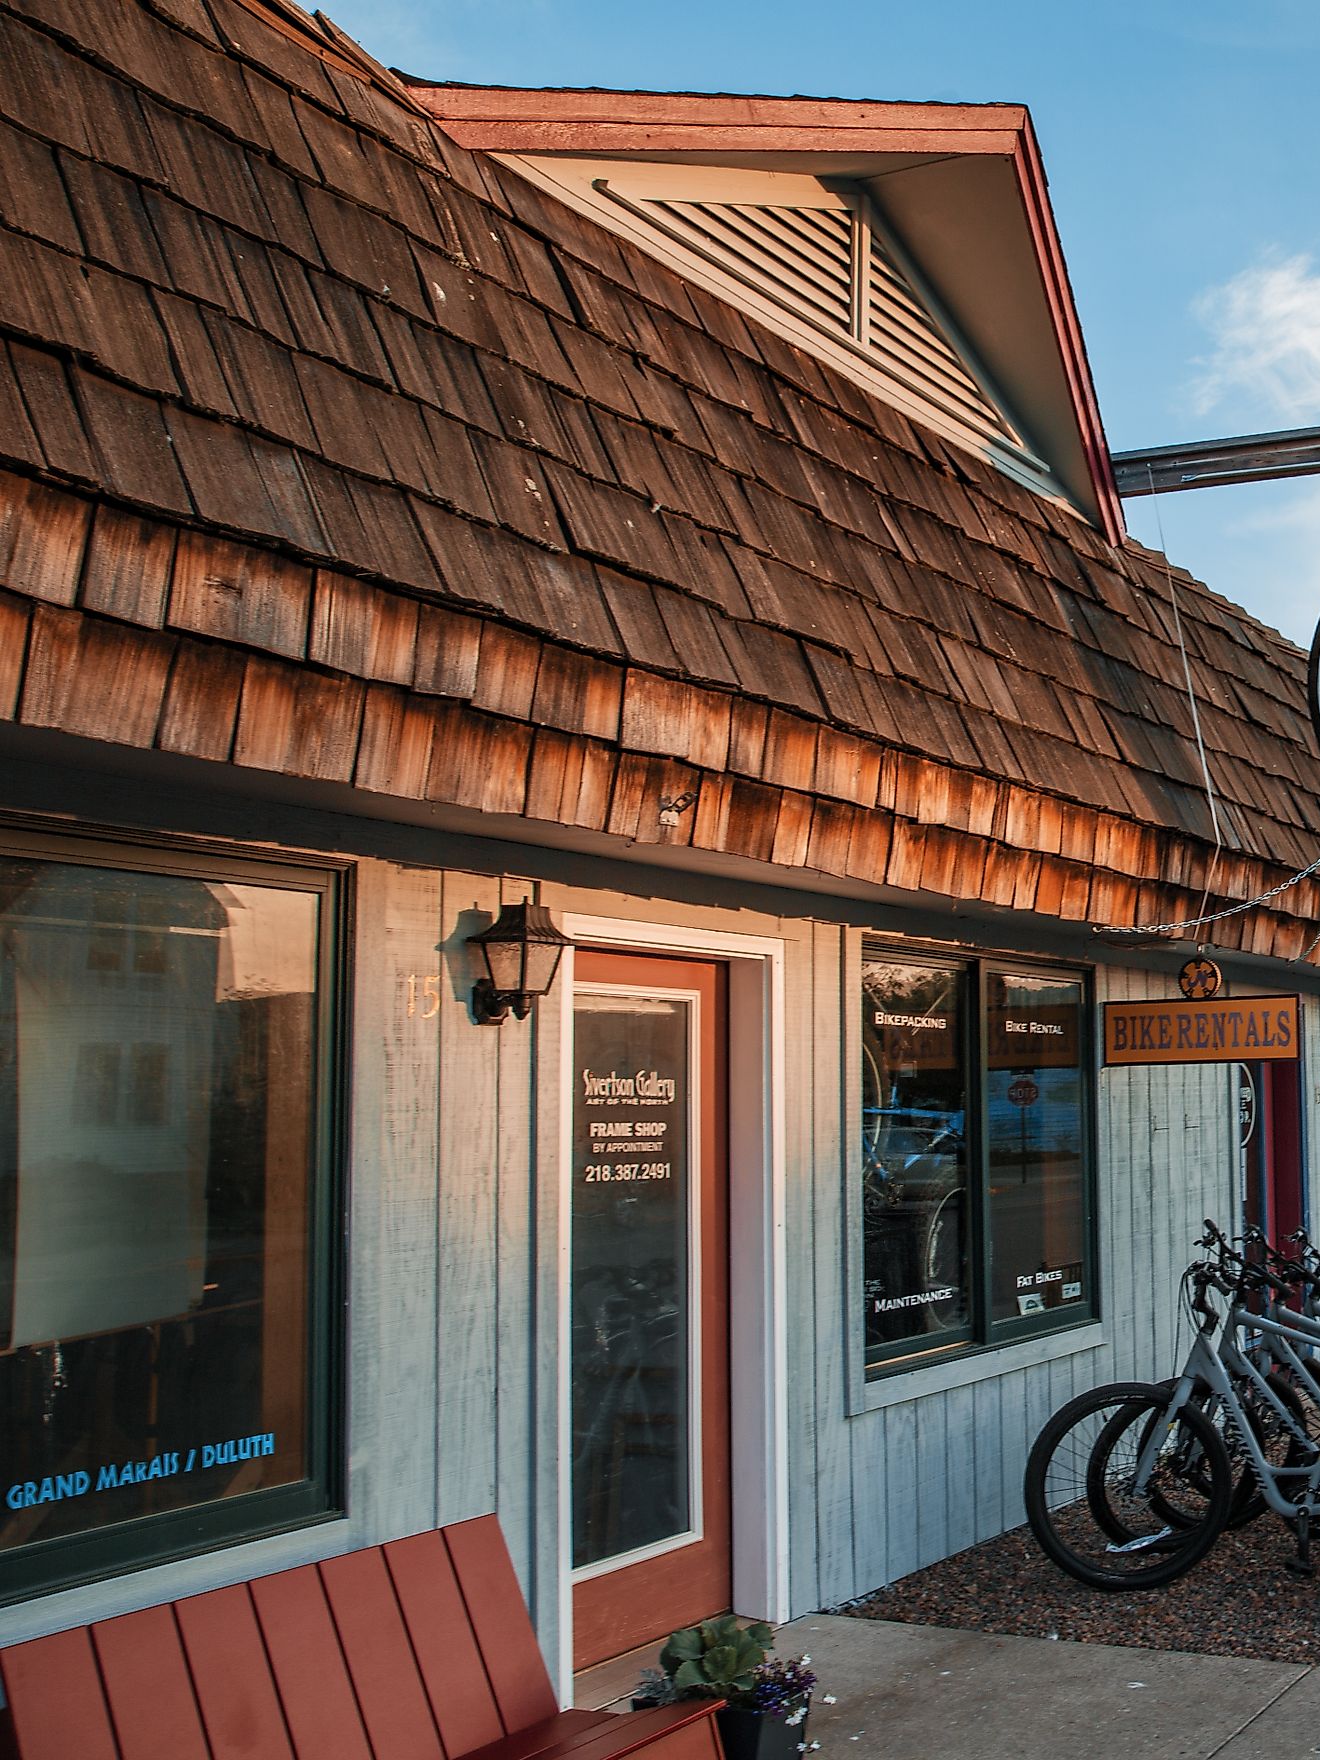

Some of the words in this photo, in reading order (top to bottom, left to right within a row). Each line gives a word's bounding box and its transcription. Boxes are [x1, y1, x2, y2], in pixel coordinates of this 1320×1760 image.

[1112, 1015, 1173, 1050] BIKE
[1176, 1010, 1291, 1049] RENTALS
[635, 1070, 676, 1103] Gallery
[589, 1122, 634, 1137] FRAME
[634, 1122, 667, 1137] SHOP
[592, 1142, 605, 1153] BY
[606, 1141, 665, 1153] APPOINTMENT
[585, 1163, 671, 1183] 218.387.2491
[1016, 1274, 1034, 1288] FAT
[1035, 1269, 1063, 1284] BIKES
[874, 1287, 952, 1313] MAINTENANCE
[6, 1470, 91, 1510] GRAND
[95, 1452, 180, 1491] MARAIS
[201, 1432, 275, 1469] DULUTH
